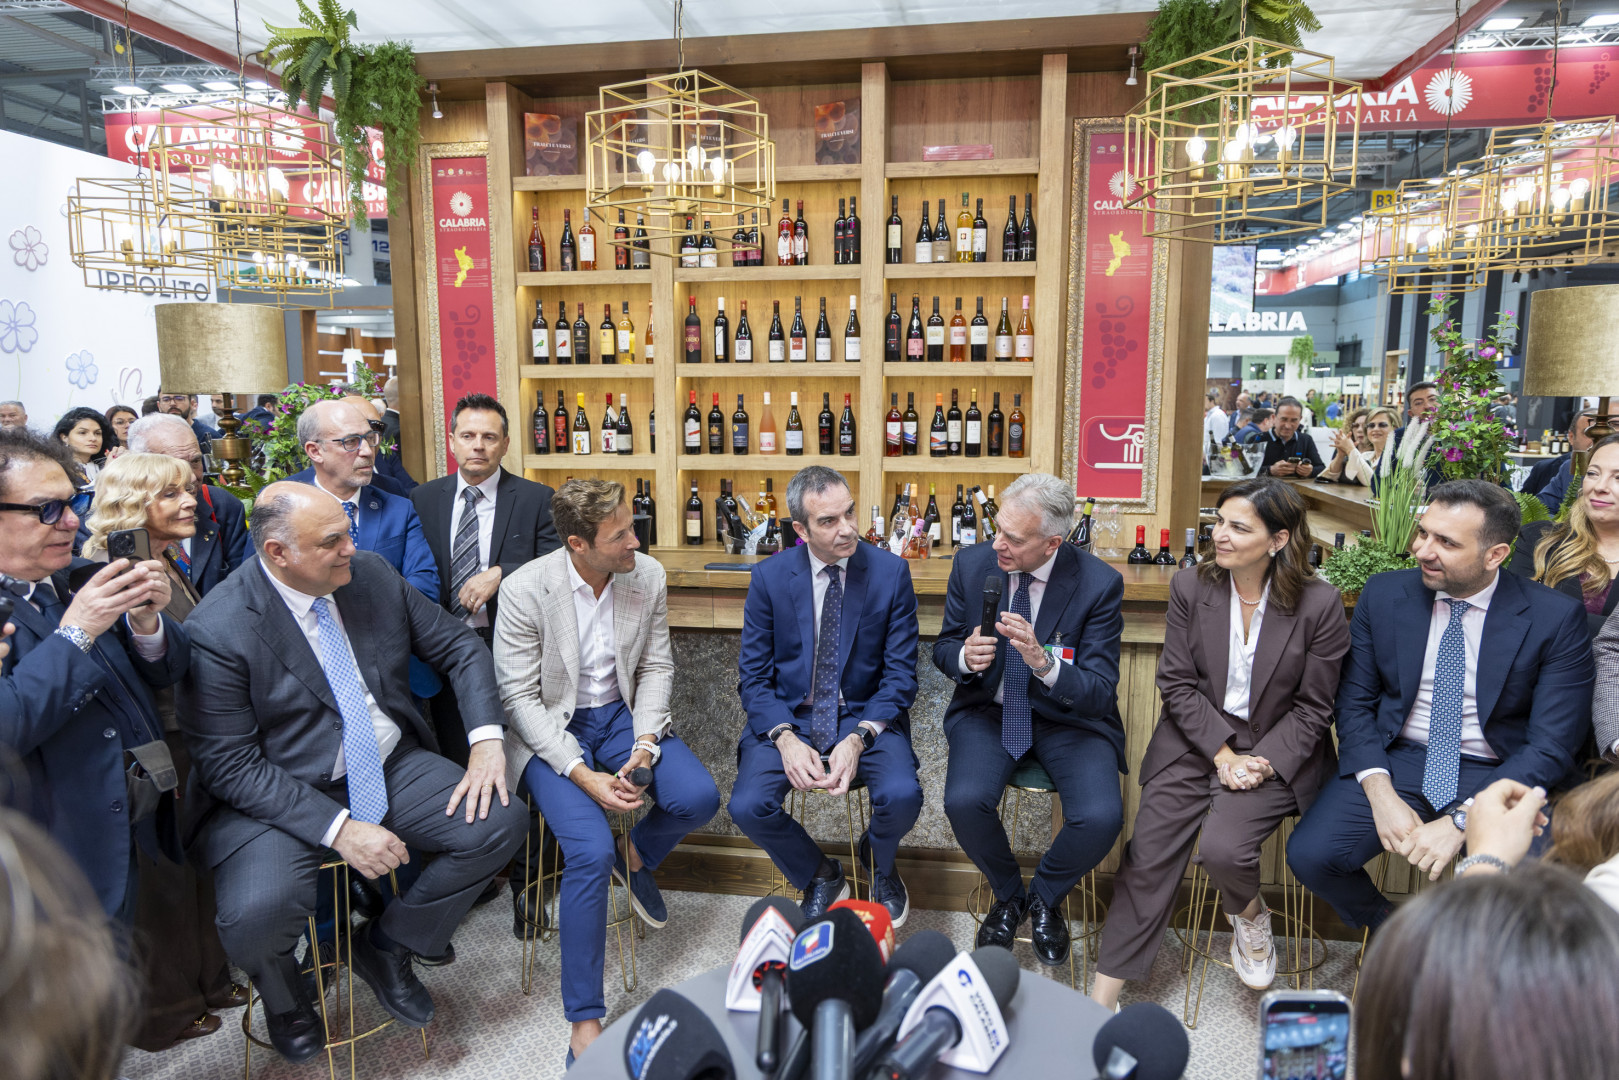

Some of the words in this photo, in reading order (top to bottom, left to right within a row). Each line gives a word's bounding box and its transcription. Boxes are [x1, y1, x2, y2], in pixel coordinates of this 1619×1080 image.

[1376, 193, 1394, 208] B3
[439, 217, 486, 228] CALABRIA
[98, 269, 209, 302] IPPOLITO
[1209, 311, 1308, 332] LABRIA
